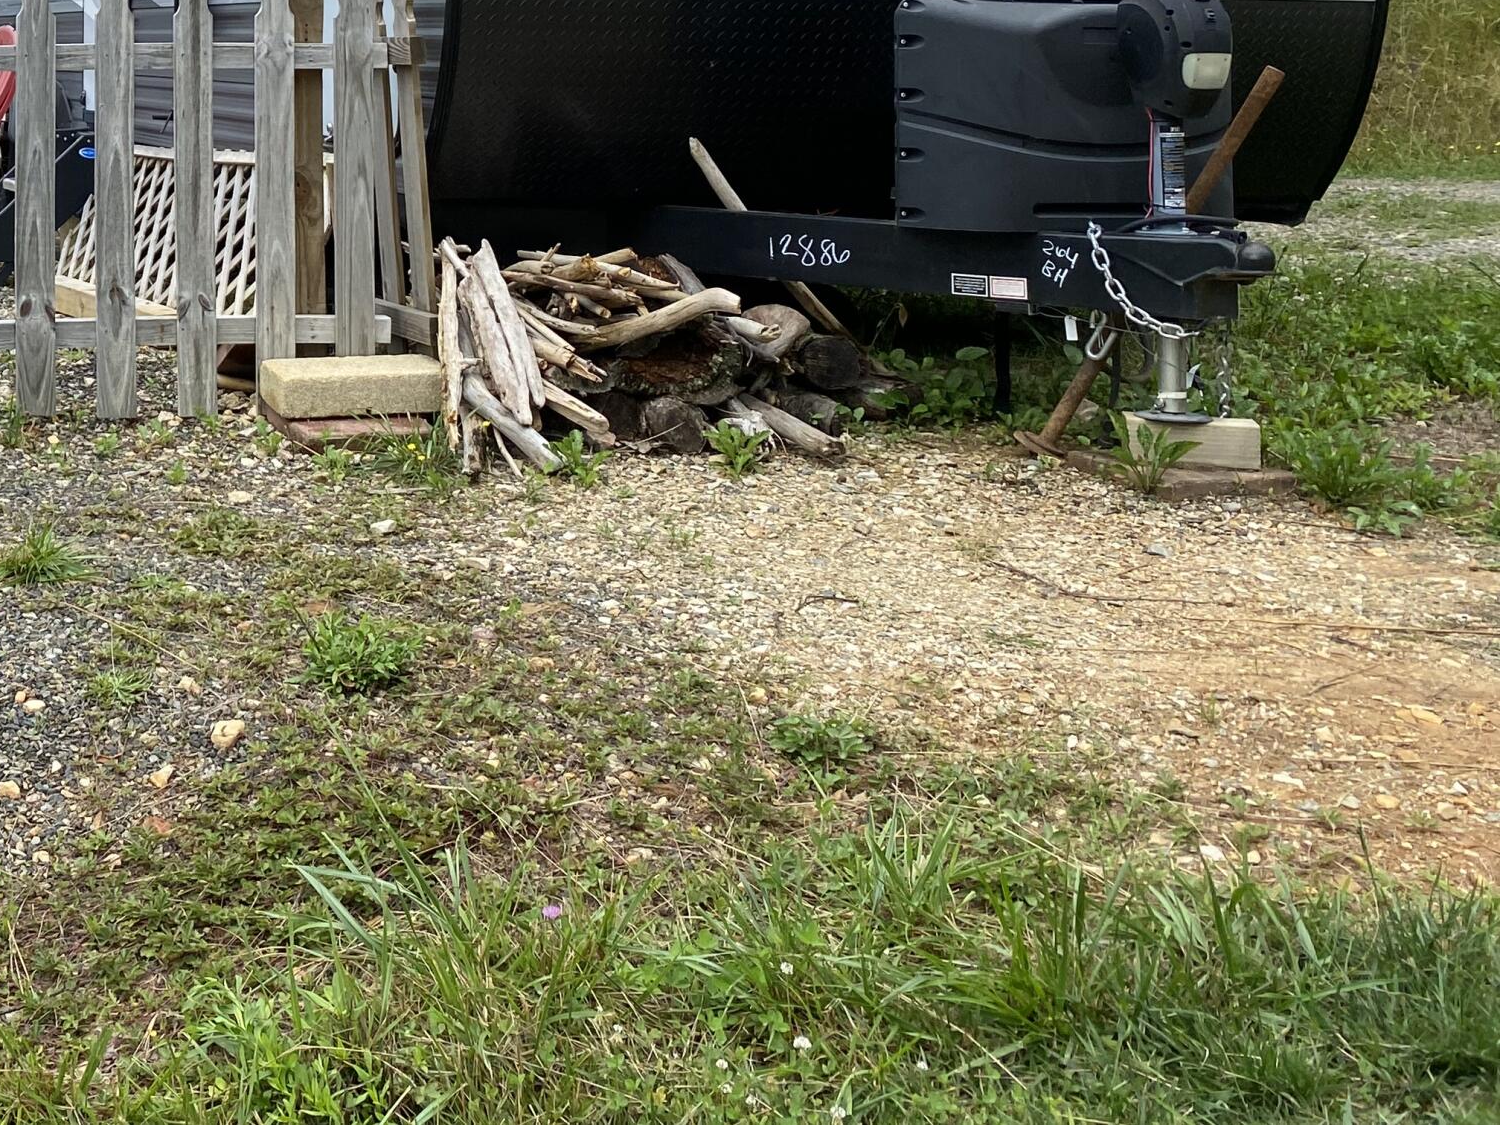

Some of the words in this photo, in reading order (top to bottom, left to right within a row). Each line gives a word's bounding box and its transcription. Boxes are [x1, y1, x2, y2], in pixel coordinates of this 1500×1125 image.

[768, 233, 851, 267] 12886
[1042, 239, 1079, 269] 264
[1041, 259, 1069, 288] BH
